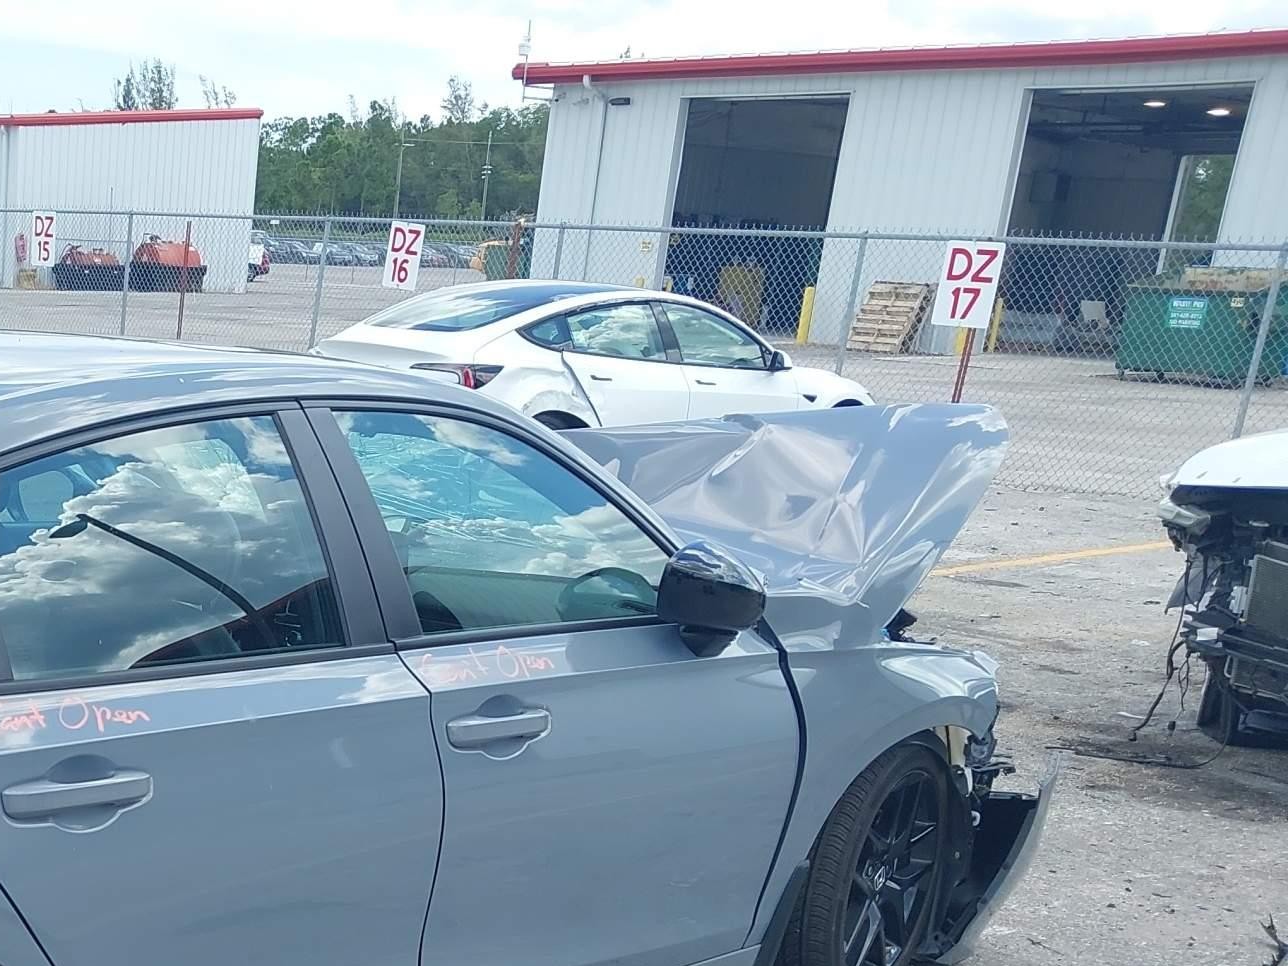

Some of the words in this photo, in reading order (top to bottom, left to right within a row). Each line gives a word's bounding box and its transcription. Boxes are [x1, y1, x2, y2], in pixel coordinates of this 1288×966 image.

[34, 215, 54, 238] DZ
[37, 240, 50, 262] 15
[391, 227, 421, 256] DZ
[391, 257, 410, 283] 16
[946, 247, 1000, 283] DZ
[950, 286, 982, 320] 17
[59, 697, 150, 733] Open
